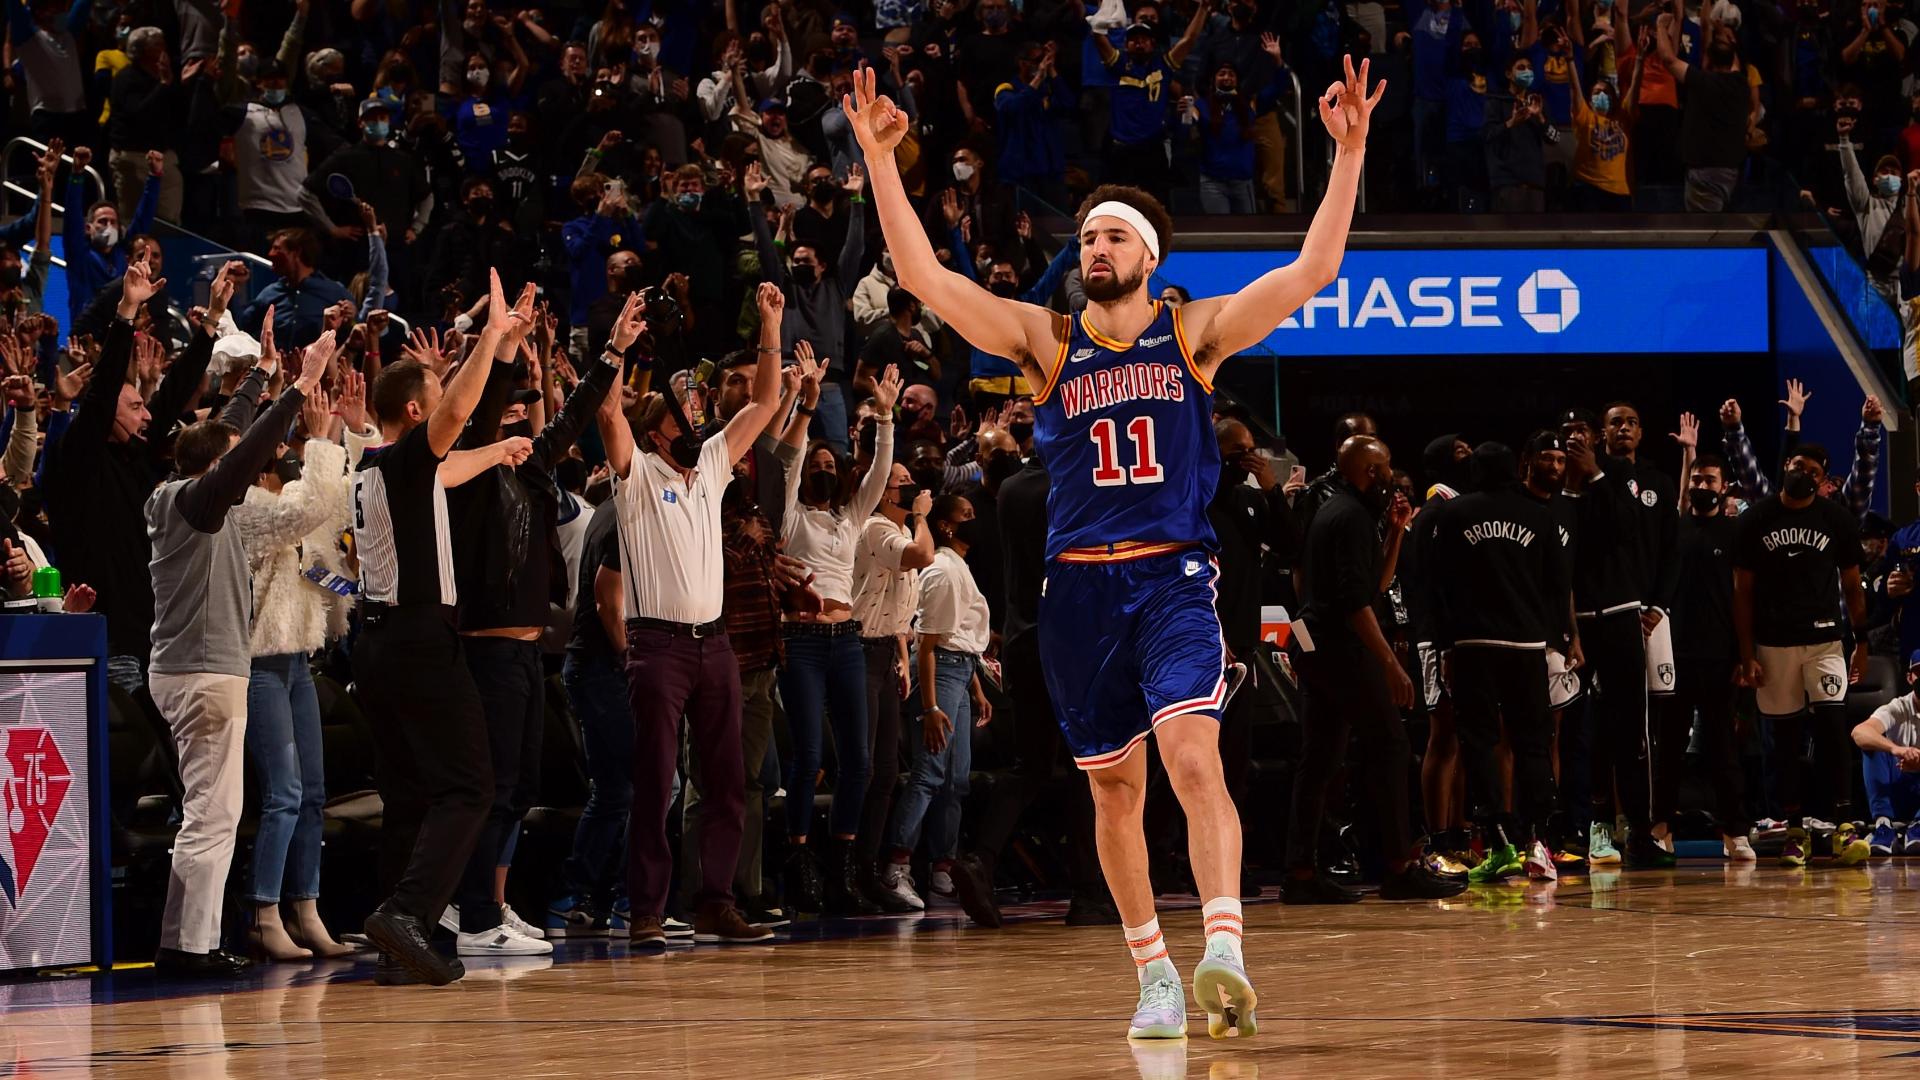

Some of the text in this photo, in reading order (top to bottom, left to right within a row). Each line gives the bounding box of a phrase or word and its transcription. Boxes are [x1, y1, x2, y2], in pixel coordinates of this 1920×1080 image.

[1139, 334, 1174, 348] Rakuten
[1059, 362, 1185, 420] WARRIORS
[1089, 415, 1165, 487] 11
[1463, 520, 1536, 548] BROOKLYN
[1762, 527, 1831, 552] BROOKLYN
[23, 751, 47, 807] 75
